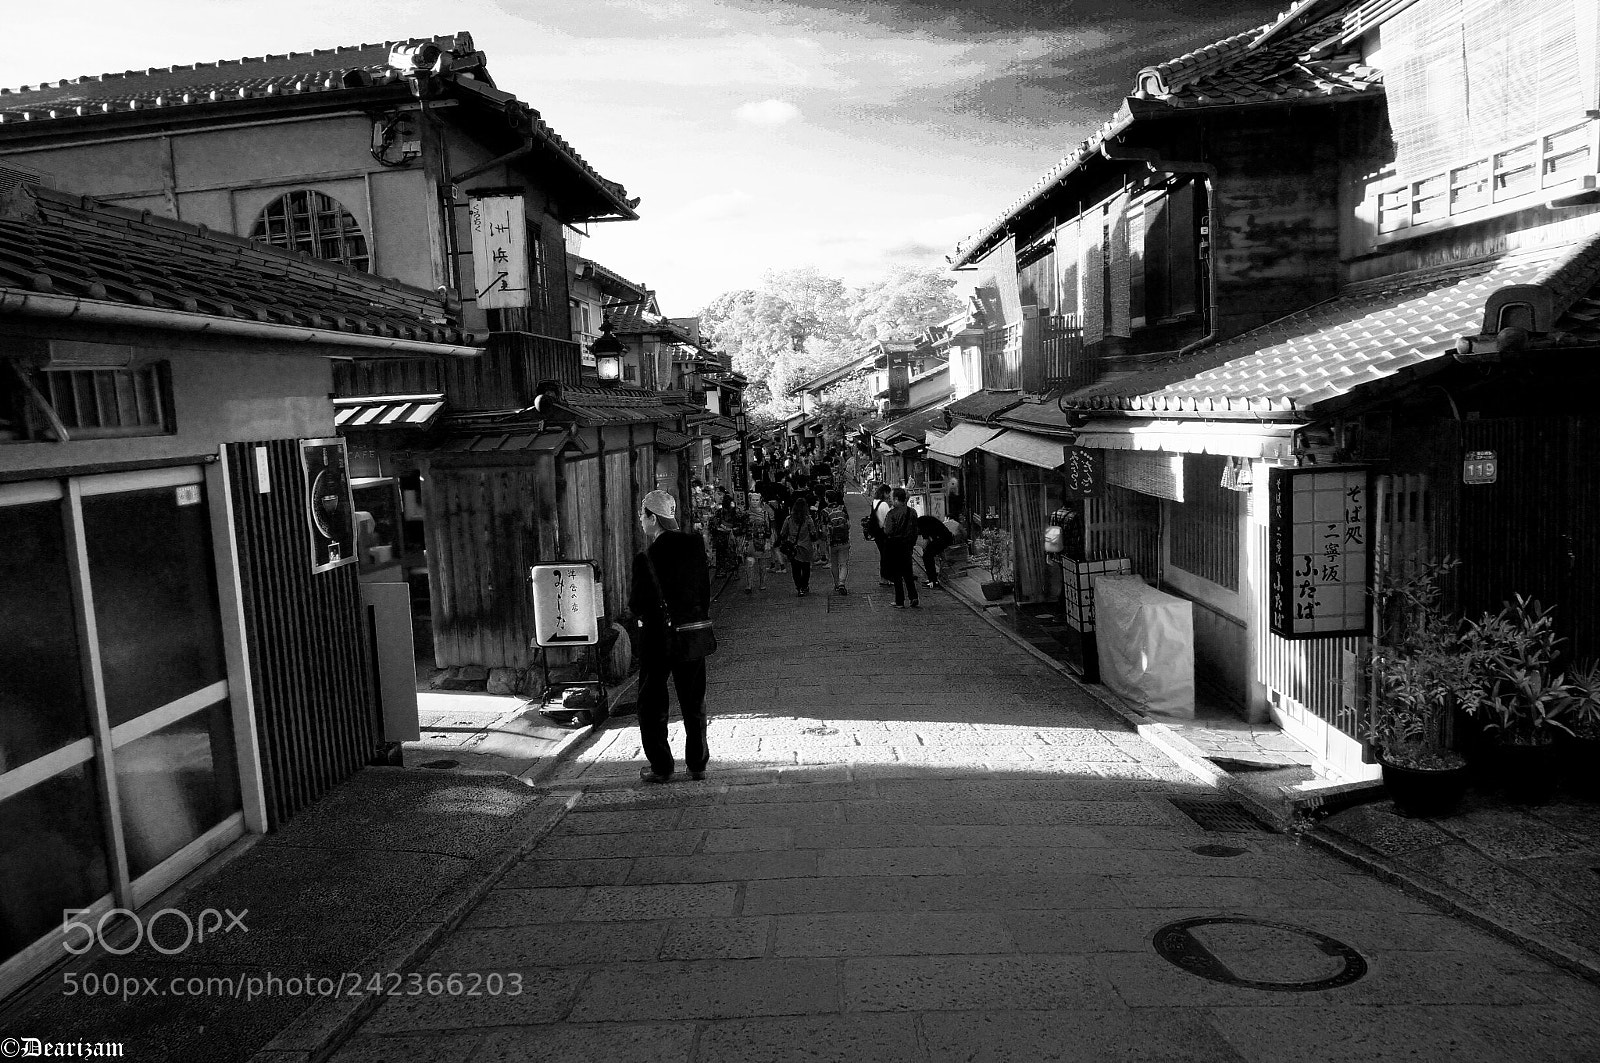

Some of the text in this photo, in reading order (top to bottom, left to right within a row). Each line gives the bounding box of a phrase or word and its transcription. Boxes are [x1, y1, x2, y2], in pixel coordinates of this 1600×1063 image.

[1468, 463, 1495, 477] 119
[1344, 485, 1363, 545] そば処
[1321, 524, 1341, 582] 二寧坂
[1273, 571, 1285, 629] ふたば
[1295, 555, 1321, 620] ふたば
